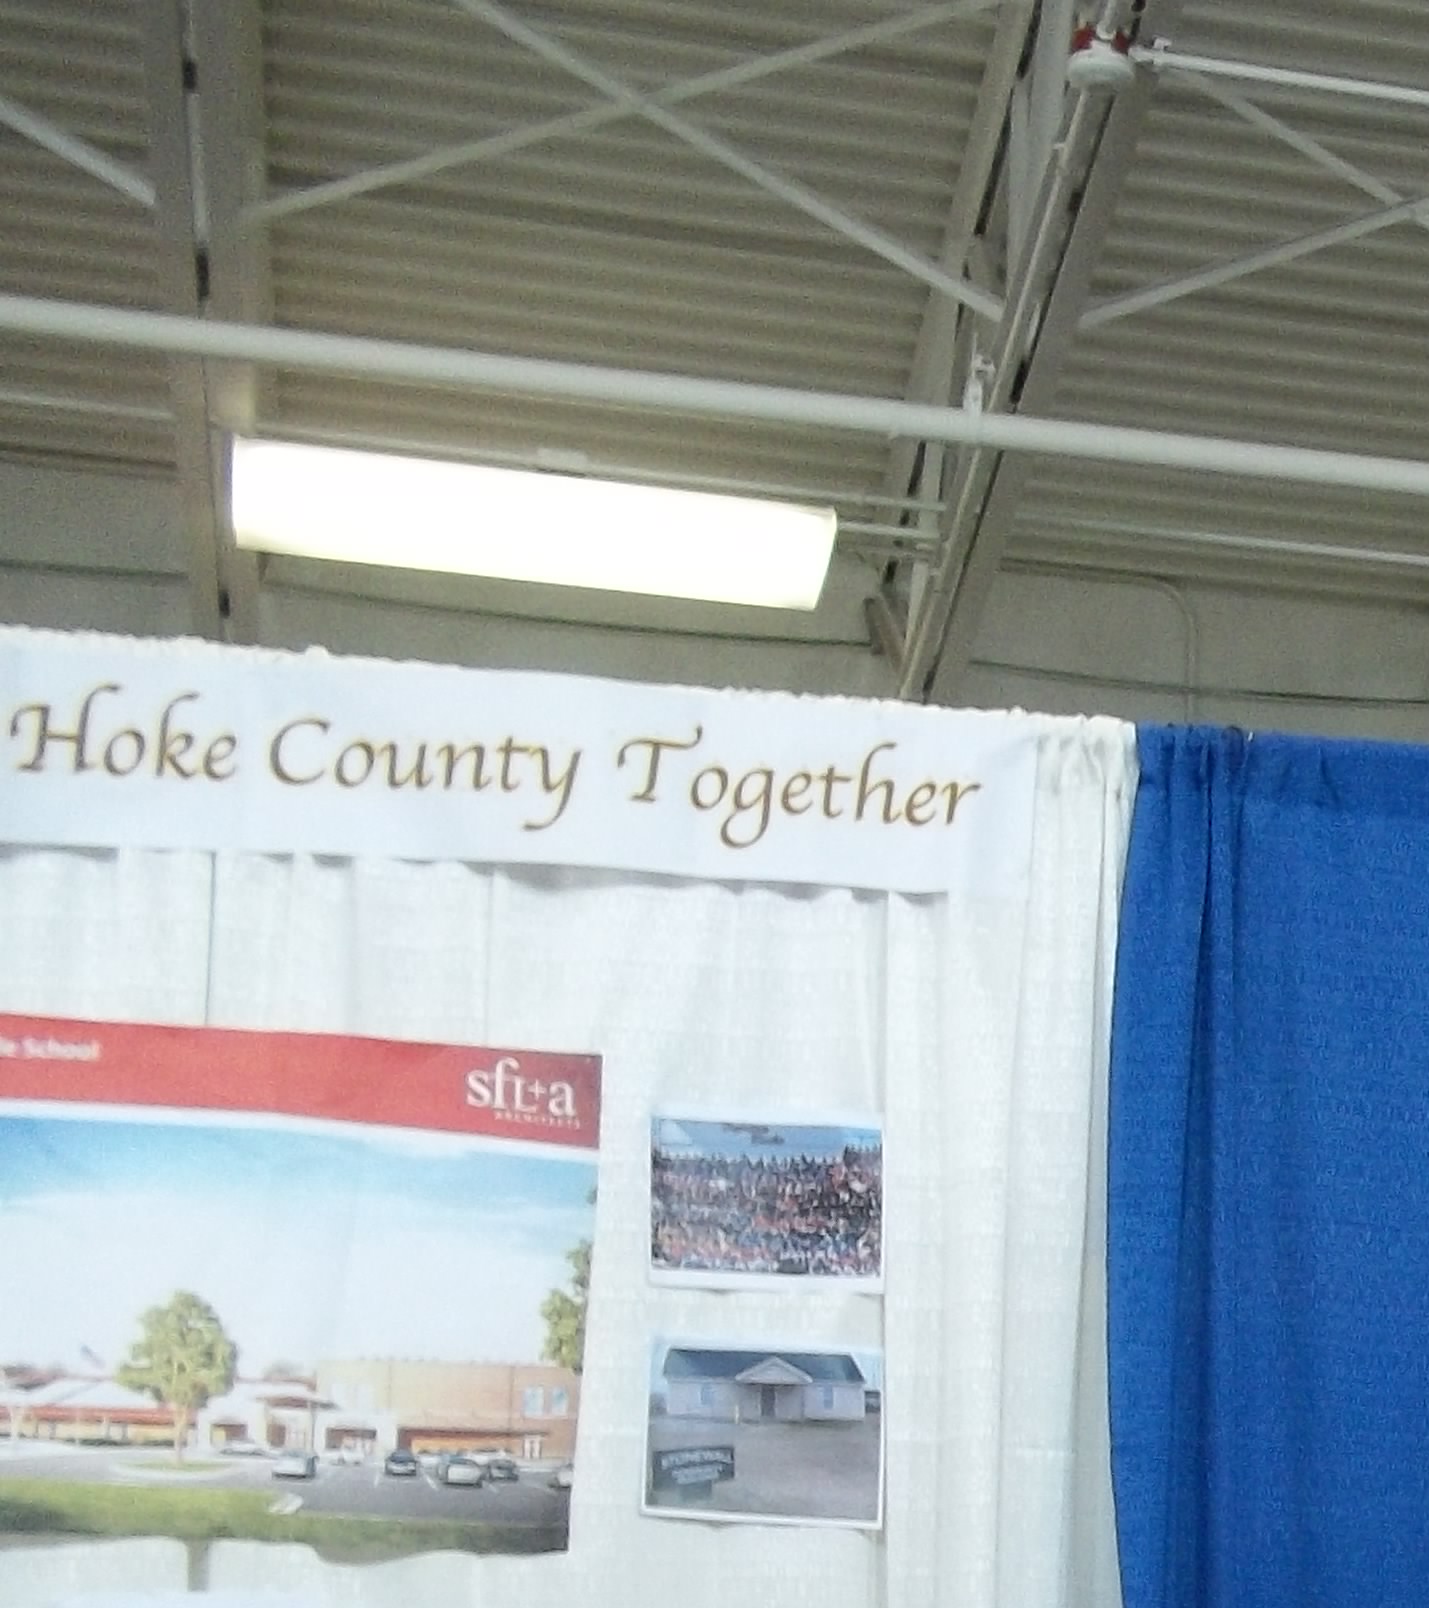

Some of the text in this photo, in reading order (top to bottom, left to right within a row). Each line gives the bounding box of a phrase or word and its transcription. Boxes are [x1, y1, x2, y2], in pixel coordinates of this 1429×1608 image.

[9, 682, 982, 849] Hoke County Together
